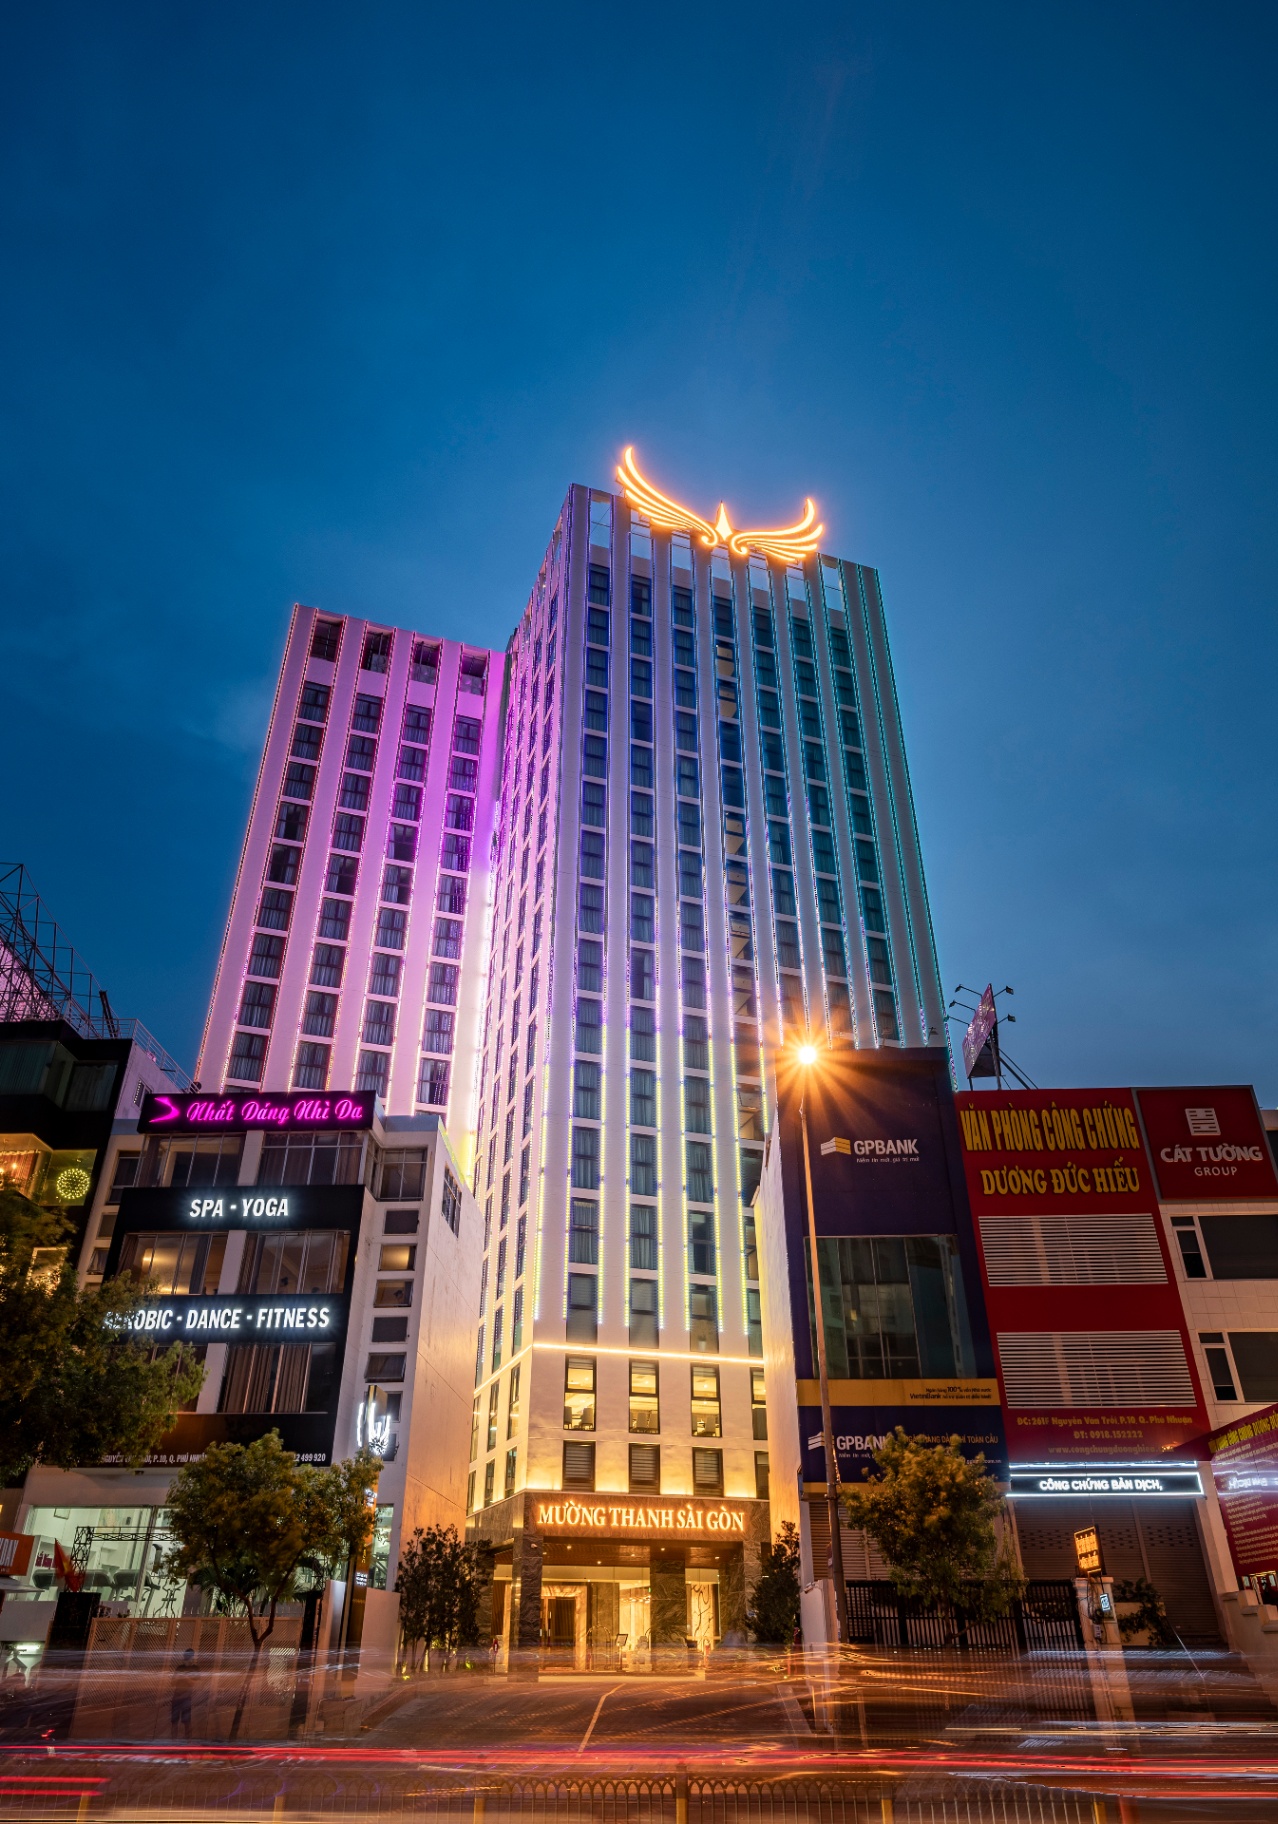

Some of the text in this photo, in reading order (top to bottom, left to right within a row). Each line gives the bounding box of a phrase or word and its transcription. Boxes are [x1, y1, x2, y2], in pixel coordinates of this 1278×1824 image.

[186, 1099, 363, 1124] Nhất Dáng Nhì Da
[960, 1100, 1140, 1151] VĂN PHÒNG CÔNG CHỨNG
[853, 1139, 919, 1155] GPBANK
[1160, 1143, 1263, 1163] CÁT TƯỜNG
[980, 1156, 1140, 1195] DƯƠNG ĐỨC HIẾU
[1194, 1166, 1238, 1176] GROUP
[189, 1198, 224, 1218] SPA
[242, 1198, 289, 1217] YOGA
[102, 1309, 174, 1331] OBIC
[186, 1309, 242, 1329] DANCE
[256, 1307, 330, 1328] FITNESS
[836, 1435, 886, 1450] GPBAN
[300, 1453, 313, 1462] 499
[313, 1453, 326, 1462] 920
[1039, 1478, 1070, 1491] CÔNG
[1071, 1478, 1109, 1491] CHỨNG
[1112, 1476, 1134, 1490] BẢN
[537, 1499, 745, 1532] MƯỜNG THANH SÀI GÒN
